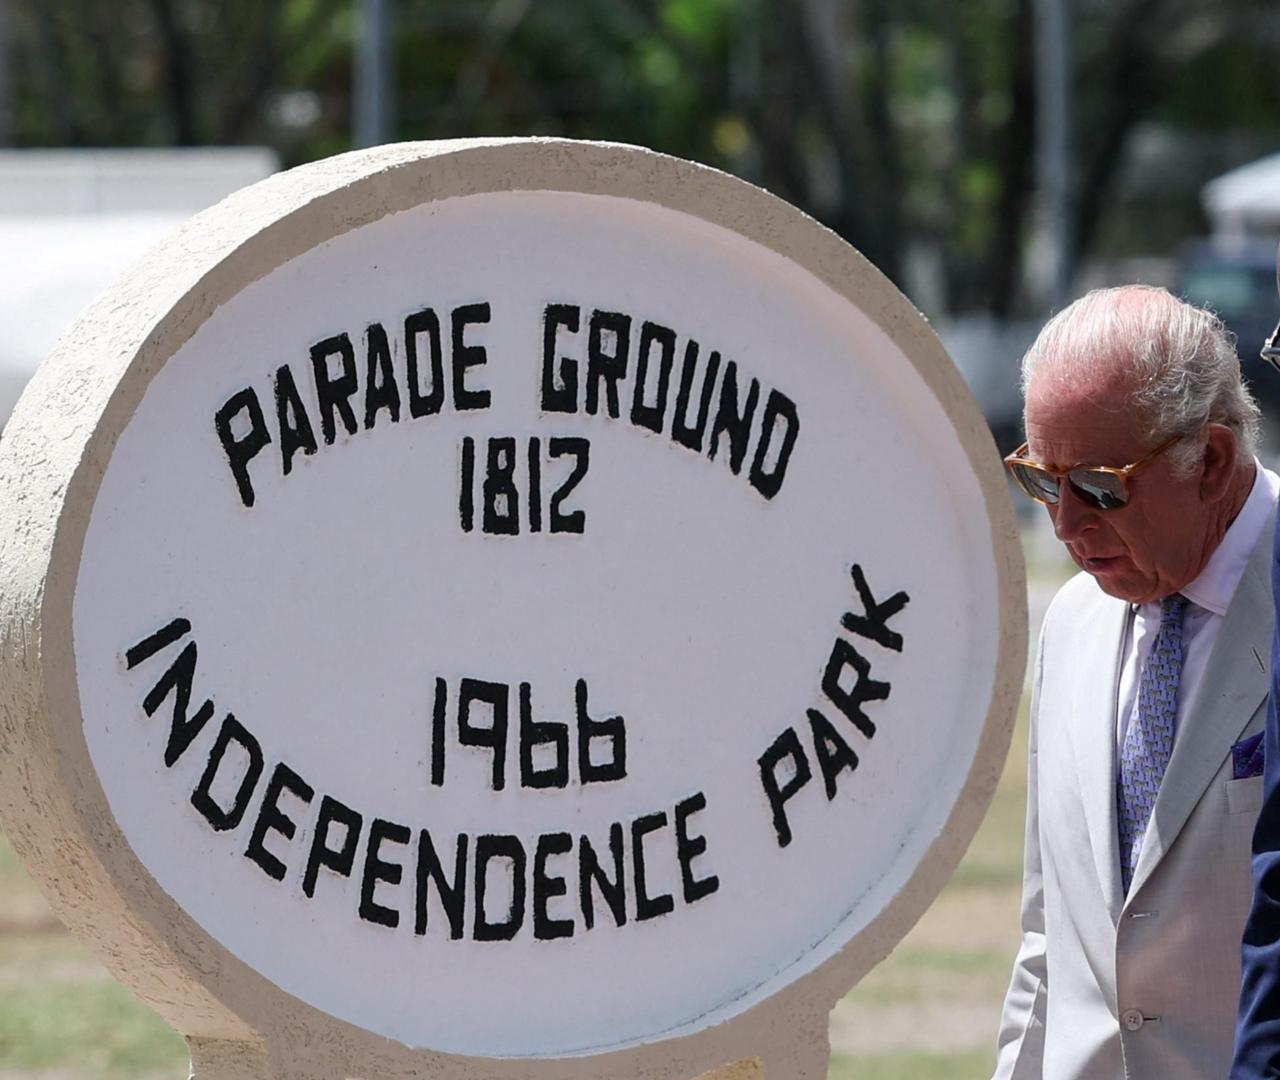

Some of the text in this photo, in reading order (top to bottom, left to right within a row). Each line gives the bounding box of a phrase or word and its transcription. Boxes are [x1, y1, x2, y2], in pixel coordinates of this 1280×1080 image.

[214, 301, 801, 508] PARADE GROUND
[458, 435, 591, 537] 1812
[124, 563, 911, 942] INDEPENDENCE PARK
[430, 676, 628, 792] 1966
